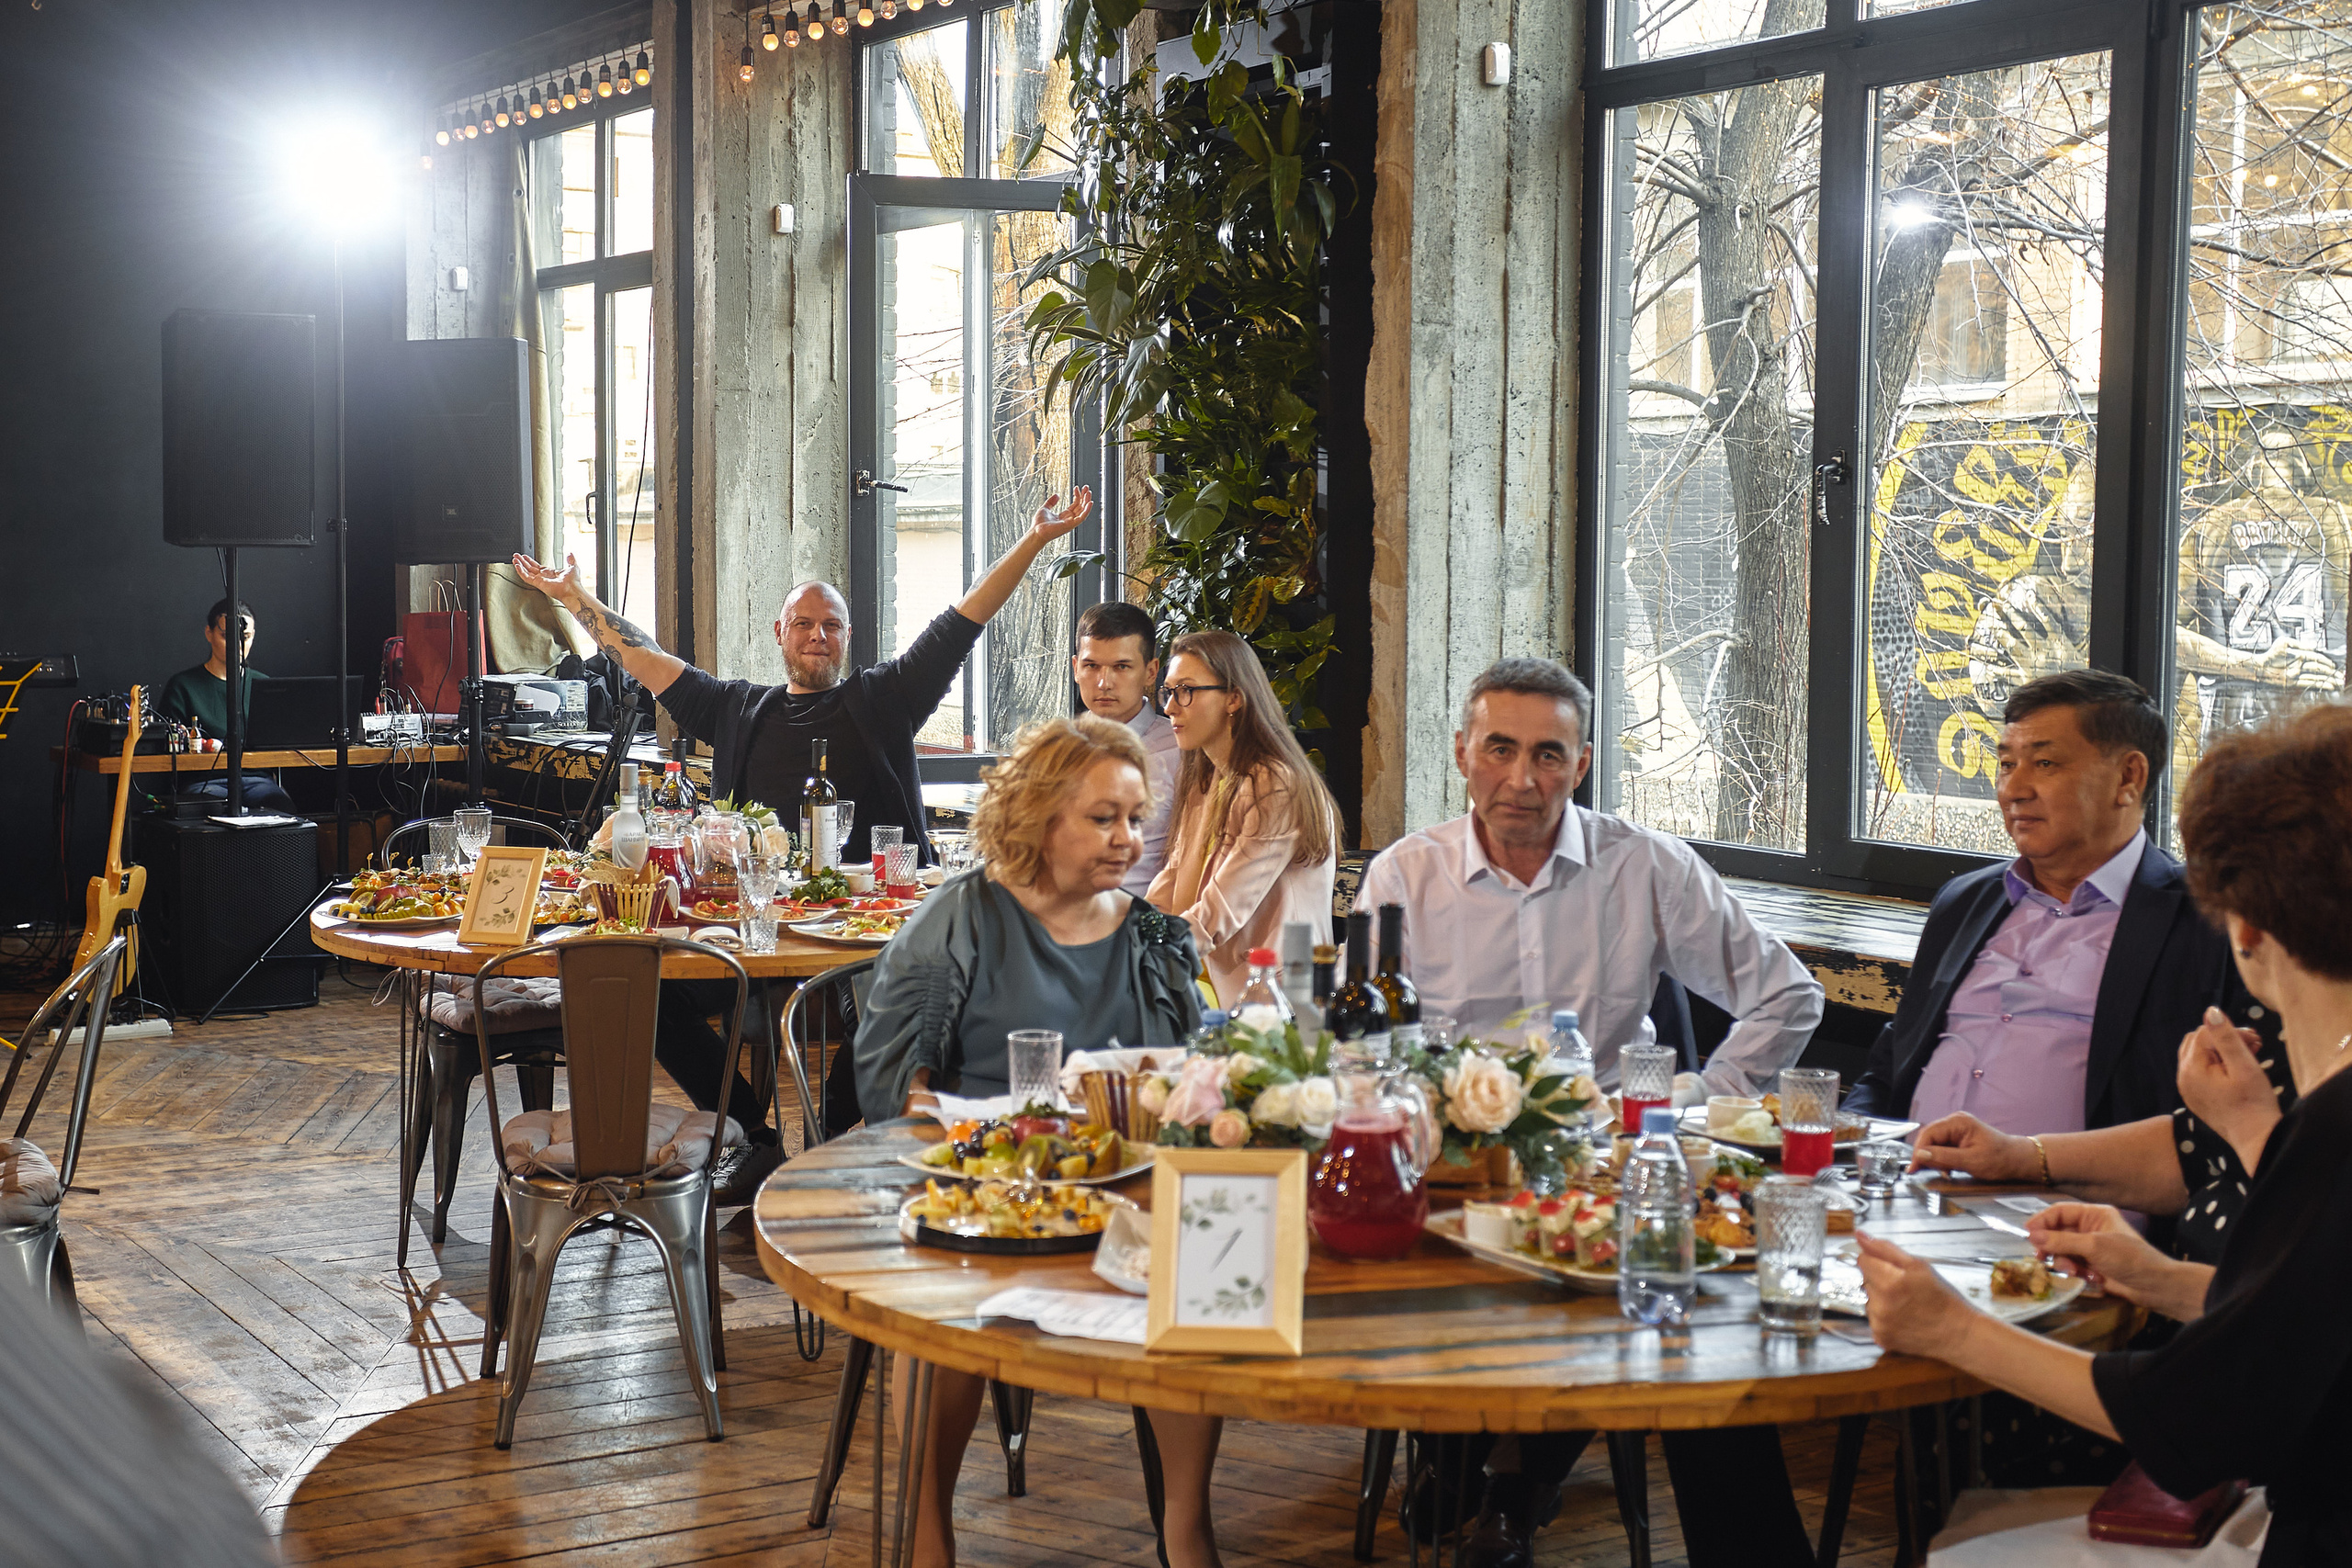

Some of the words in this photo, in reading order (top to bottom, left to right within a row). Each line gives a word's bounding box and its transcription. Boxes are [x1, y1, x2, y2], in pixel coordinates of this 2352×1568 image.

[2224, 563, 2328, 651] 24
[491, 885, 514, 905] 3
[1208, 1227, 1243, 1274] 1
